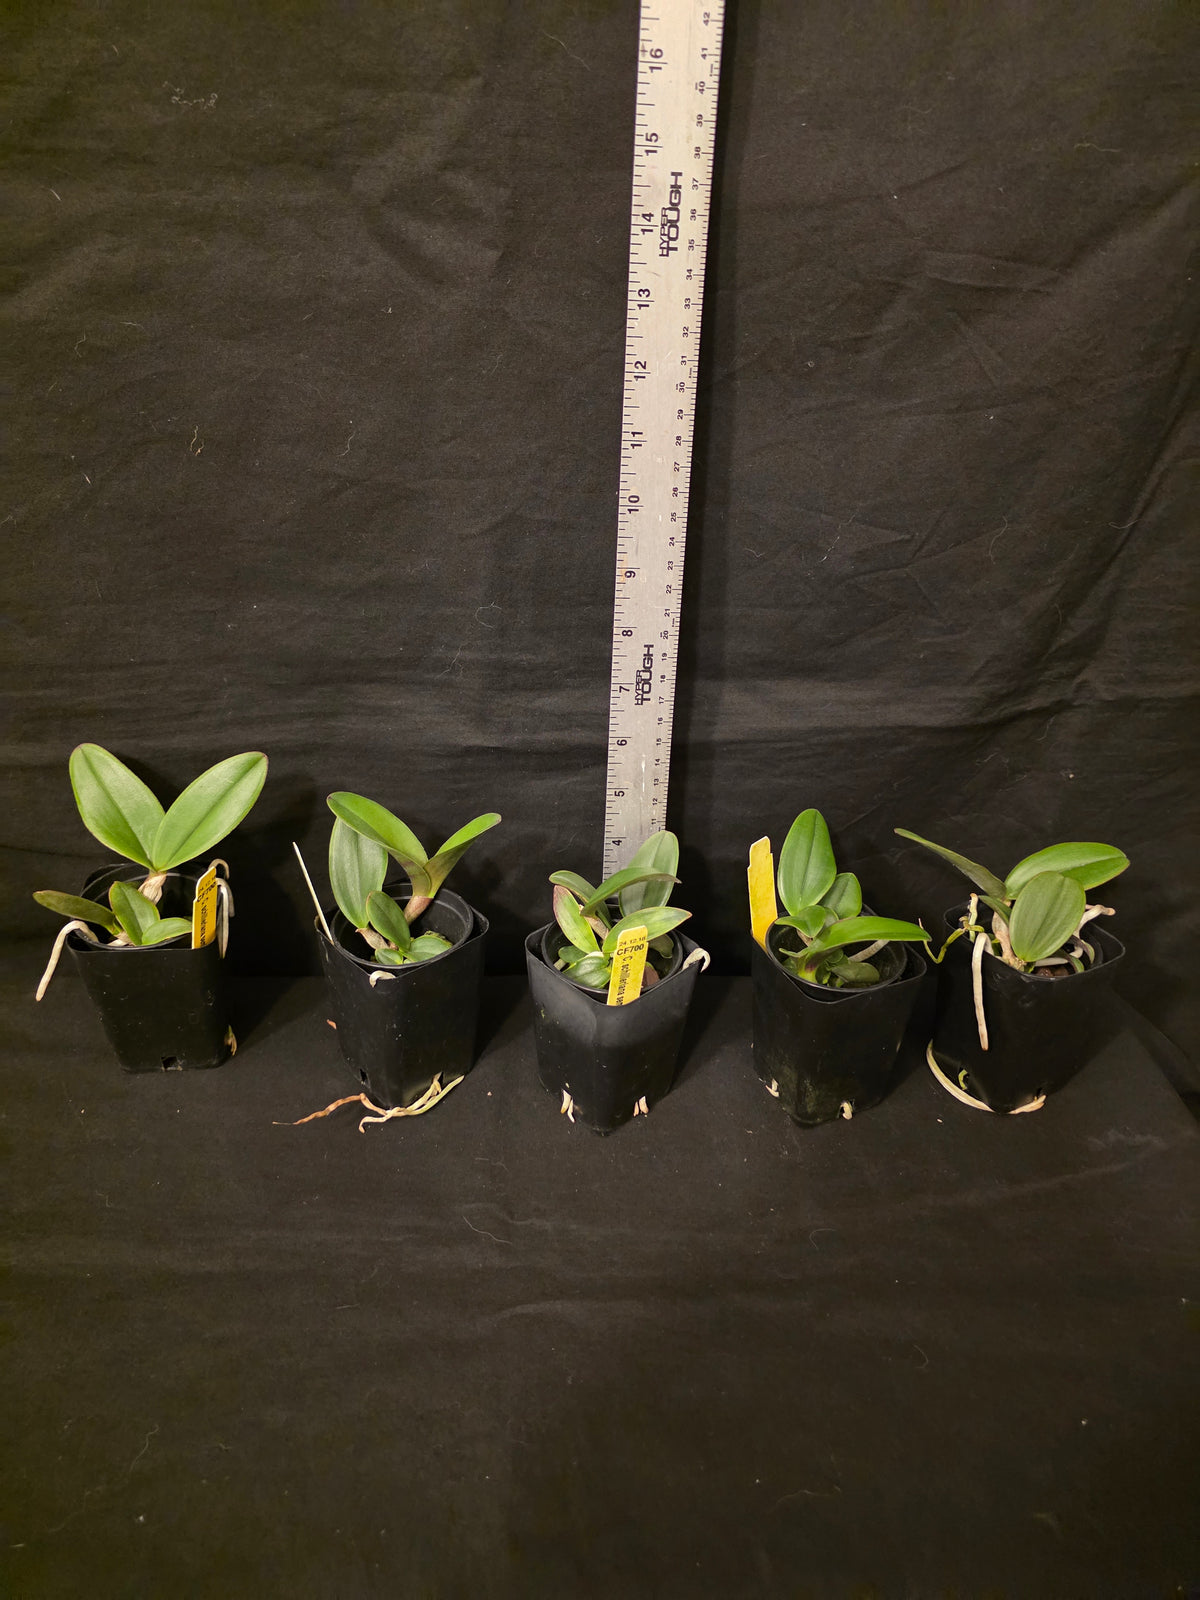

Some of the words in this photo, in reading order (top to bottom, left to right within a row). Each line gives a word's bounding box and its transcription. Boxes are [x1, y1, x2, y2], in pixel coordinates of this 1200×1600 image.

[703, 12, 710, 26] 42
[701, 47, 708, 60] 41
[648, 48, 664, 73] 16
[698, 81, 706, 94] 40
[696, 114, 704, 127] 39
[644, 132, 659, 156] 15
[694, 146, 701, 159] 38
[692, 178, 699, 190] 37
[667, 171, 683, 251] TOUGH
[690, 208, 697, 221] 36
[640, 212, 654, 235] 14
[659, 207, 669, 257] HYPER
[688, 239, 695, 251] 35
[686, 268, 693, 280] 34
[637, 288, 651, 310] 13
[684, 298, 691, 310] 33
[682, 326, 689, 338] 32
[680, 355, 687, 366] 31
[633, 360, 647, 381] 12
[679, 382, 686, 393] 30
[677, 409, 684, 420] 29
[630, 431, 643, 449] 11
[675, 435, 682, 446] 28
[674, 462, 680, 472] 27
[672, 487, 679, 497] 26
[627, 495, 640, 514] 10
[670, 512, 677, 522] 25
[669, 536, 675, 546] 24
[667, 560, 674, 571] 23
[624, 570, 636, 579] 9
[666, 584, 672, 594] 22
[664, 608, 670, 617] 21
[621, 629, 633, 637] 8
[662, 630, 669, 640] 20
[661, 652, 667, 661] 19
[641, 644, 654, 702] TOUGH
[660, 674, 666, 683] 18
[619, 685, 630, 693] 7
[635, 670, 643, 706] HYPER
[659, 696, 665, 704] 17
[616, 943, 645, 956] CF700
